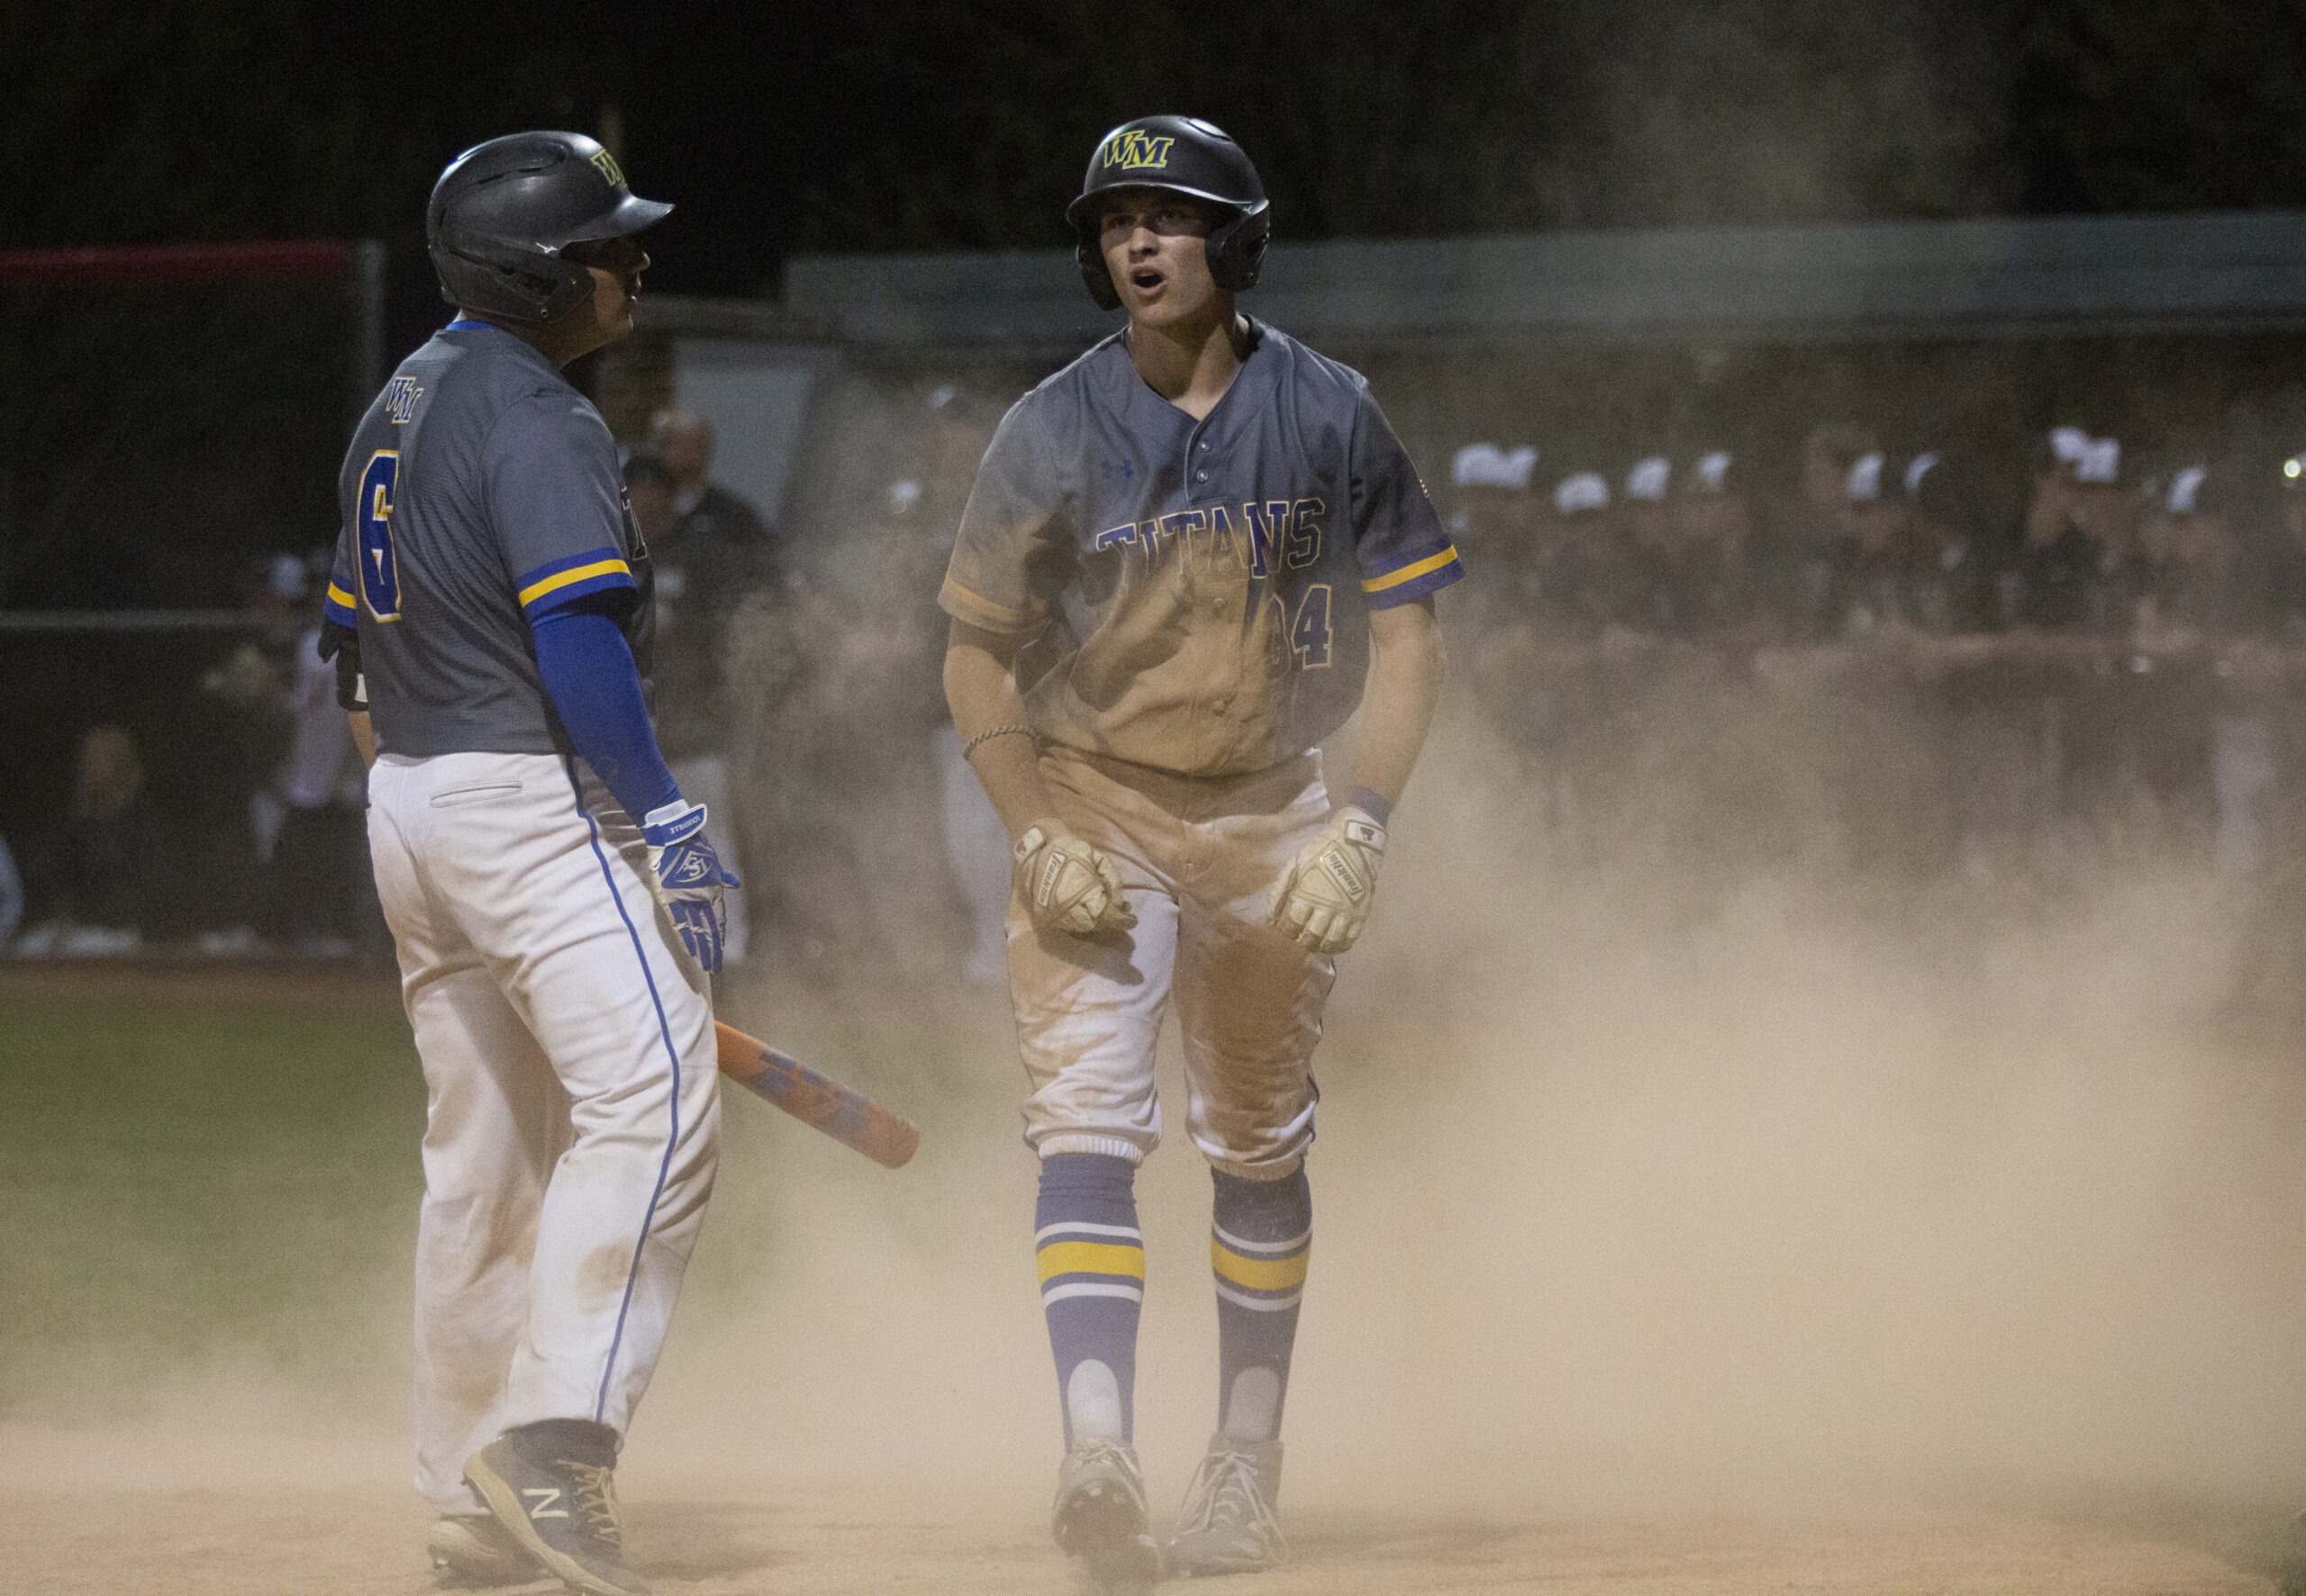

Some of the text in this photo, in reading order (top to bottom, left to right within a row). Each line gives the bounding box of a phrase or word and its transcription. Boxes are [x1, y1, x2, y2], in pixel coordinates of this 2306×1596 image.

[1103, 130, 1176, 169] WM
[386, 376, 424, 423] WM
[357, 449, 402, 622] 6
[1096, 497, 1326, 579] TITANS
